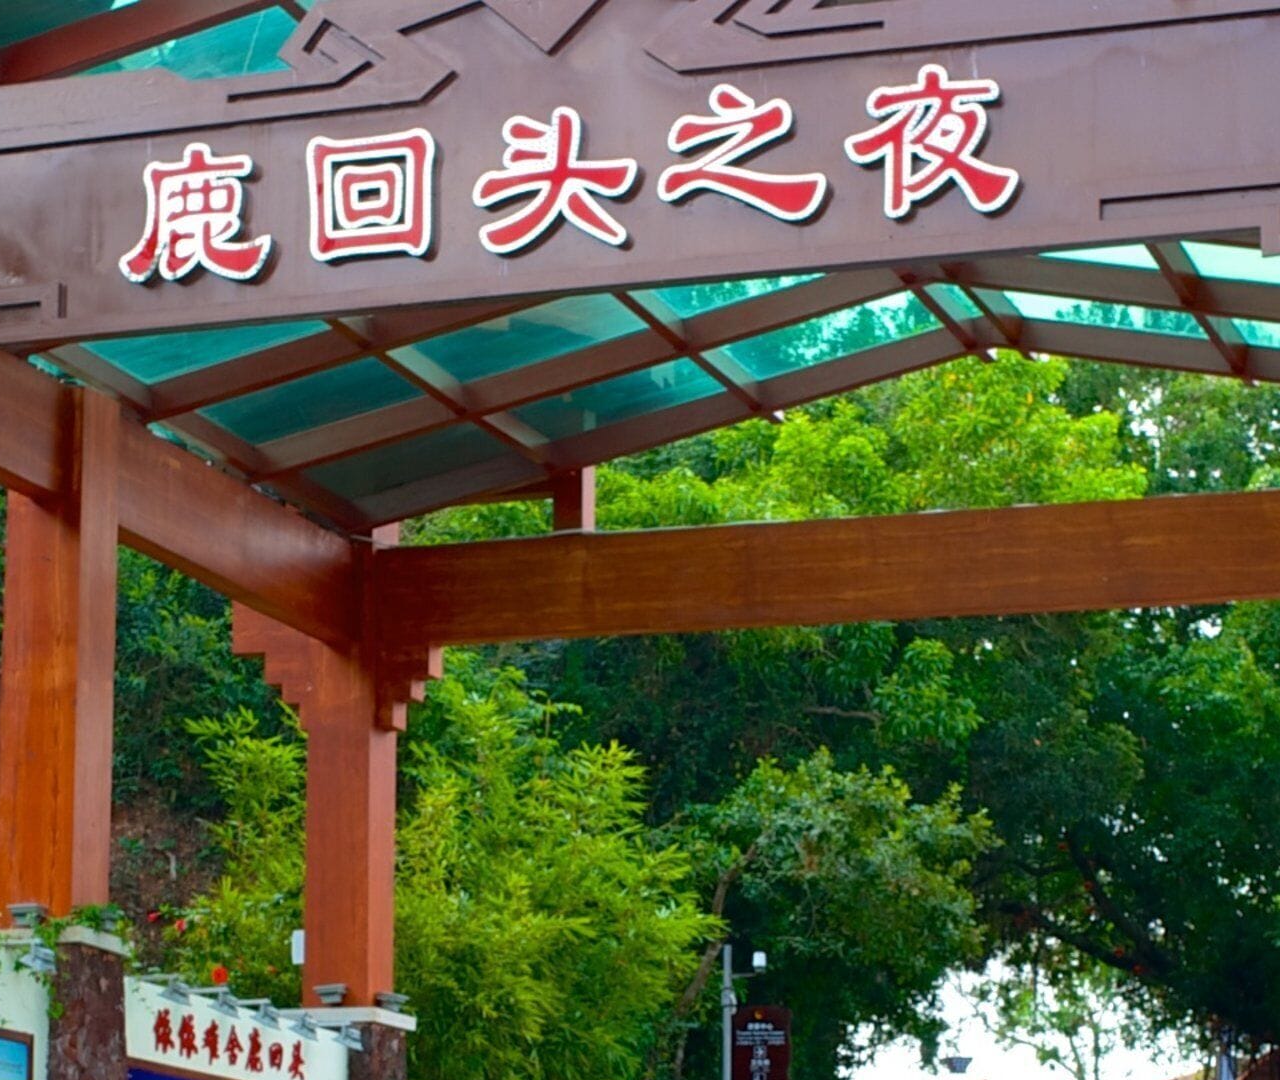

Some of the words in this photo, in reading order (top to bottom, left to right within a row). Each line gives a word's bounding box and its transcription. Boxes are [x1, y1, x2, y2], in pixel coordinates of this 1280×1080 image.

[118, 63, 1019, 285] 鹿回头之夜
